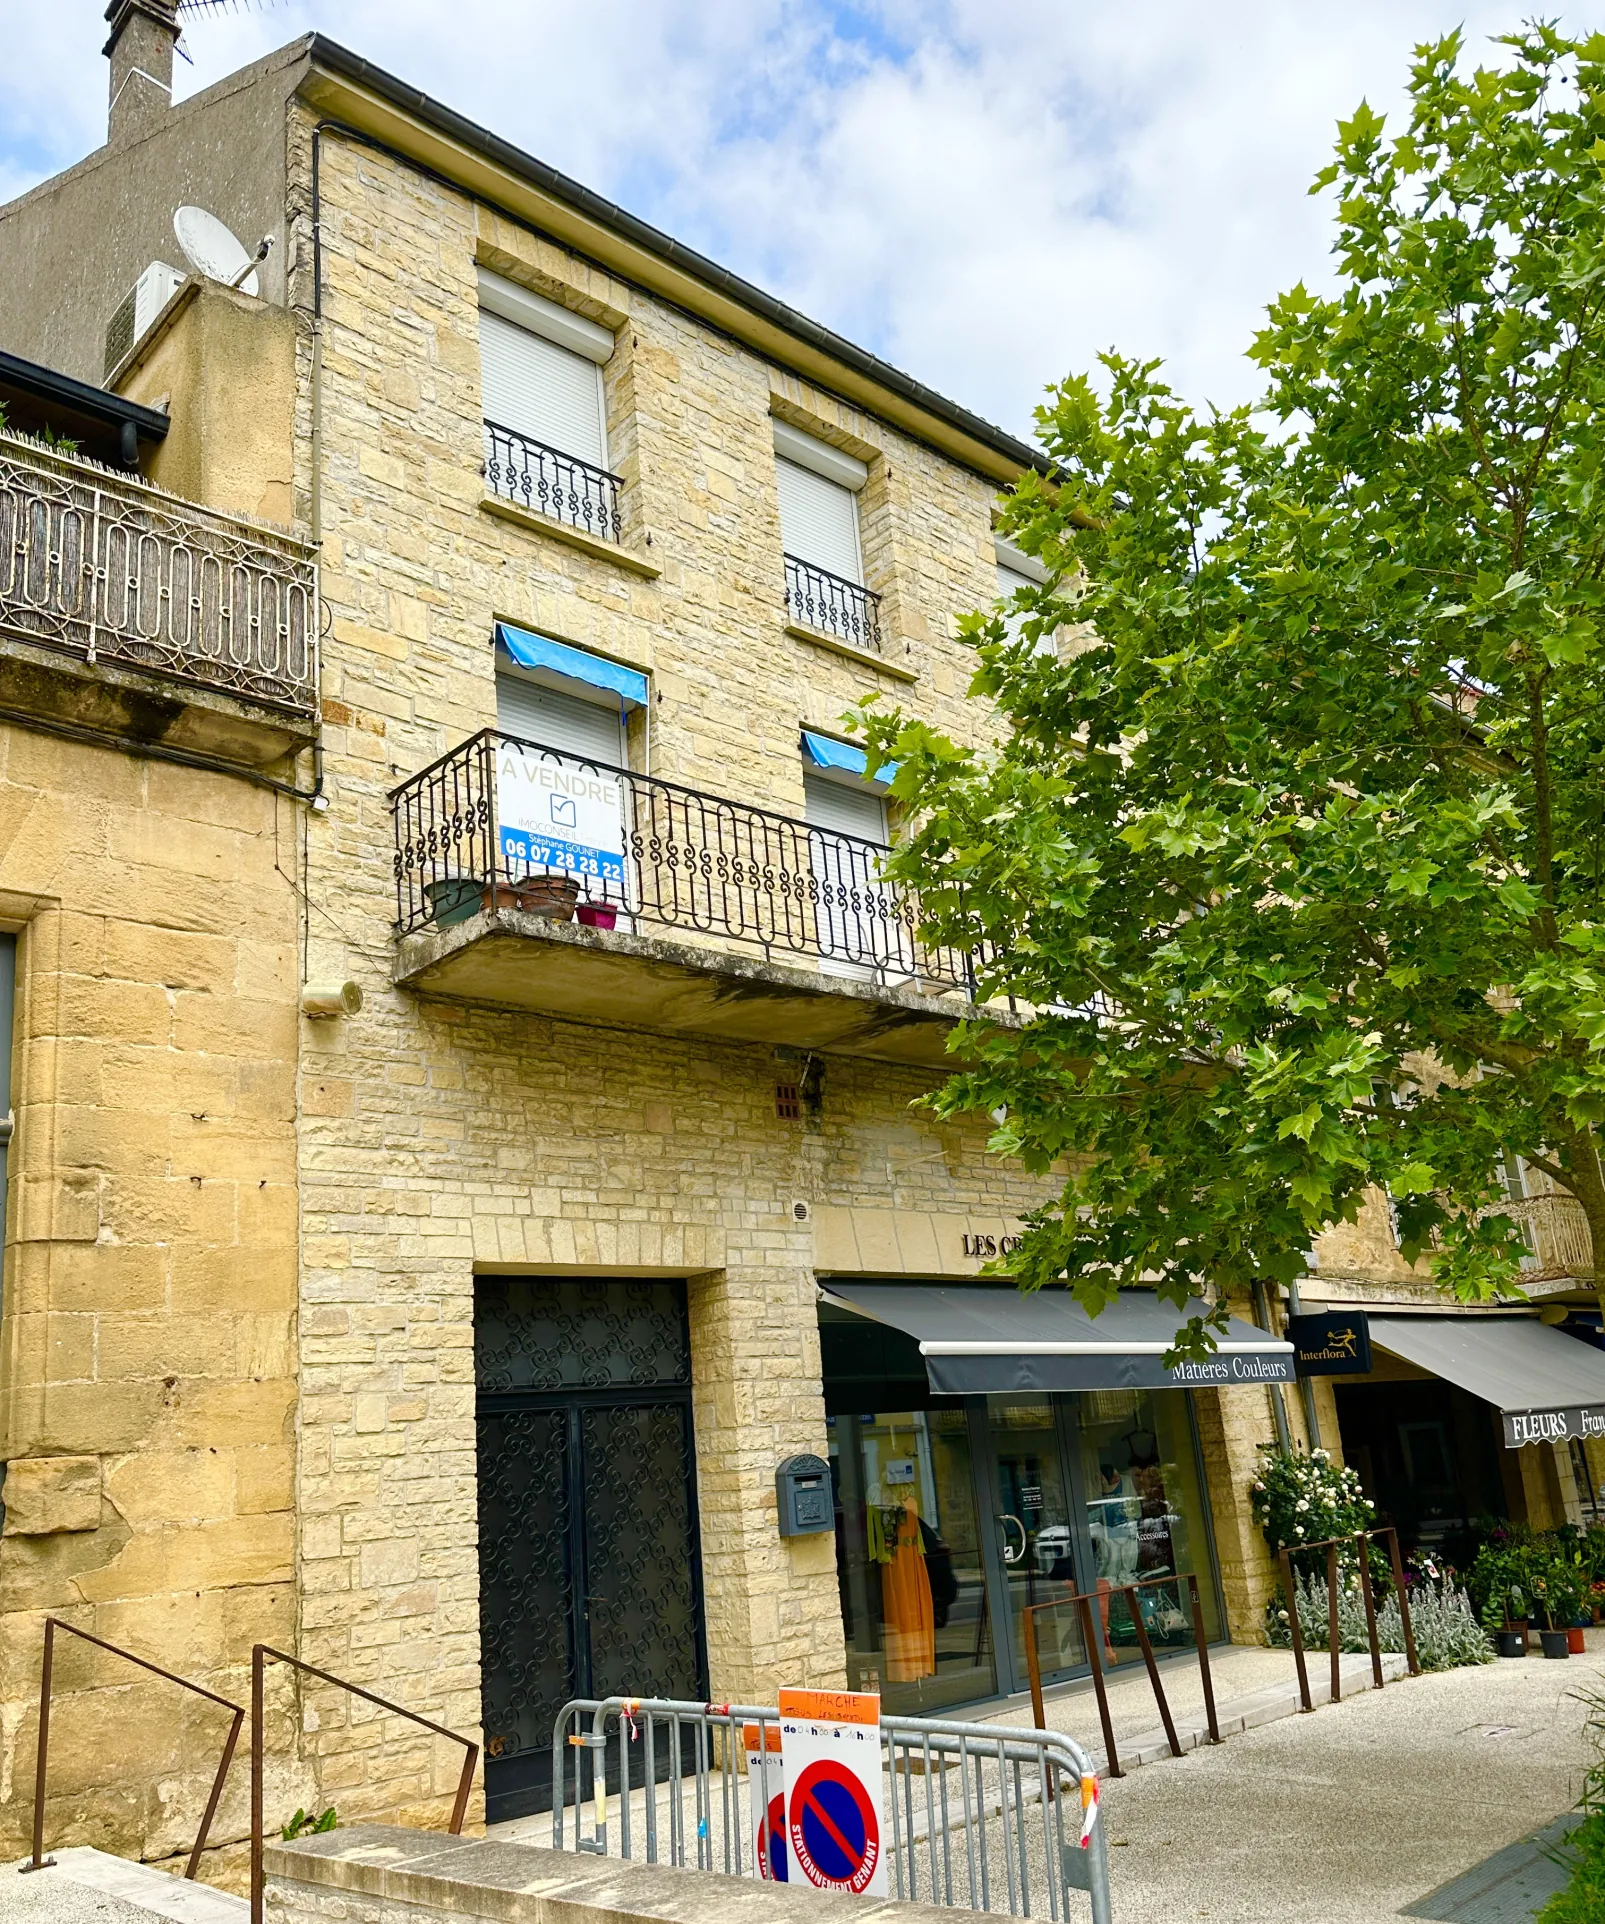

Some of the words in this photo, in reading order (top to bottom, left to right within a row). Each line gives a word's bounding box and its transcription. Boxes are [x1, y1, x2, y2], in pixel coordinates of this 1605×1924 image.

[501, 757, 517, 779] A
[523, 762, 616, 806] VENDRE
[505, 838, 526, 858] 06
[530, 844, 551, 863] 07
[555, 850, 576, 869] 28
[579, 856, 599, 875] 28
[602, 861, 621, 880] 22
[565, 842, 600, 859] GOUNET
[962, 1234, 997, 1256] LES
[1300, 1348, 1346, 1360] Interflora
[1172, 1361, 1229, 1380] Matières
[1232, 1356, 1287, 1378] Couleurs
[1511, 1412, 1567, 1440] FLEURS
[1136, 1530, 1169, 1541] Accessoires
[783, 1724, 796, 1734] de
[833, 1727, 840, 1738] à
[792, 1824, 853, 1893] STATIONNEMENT
